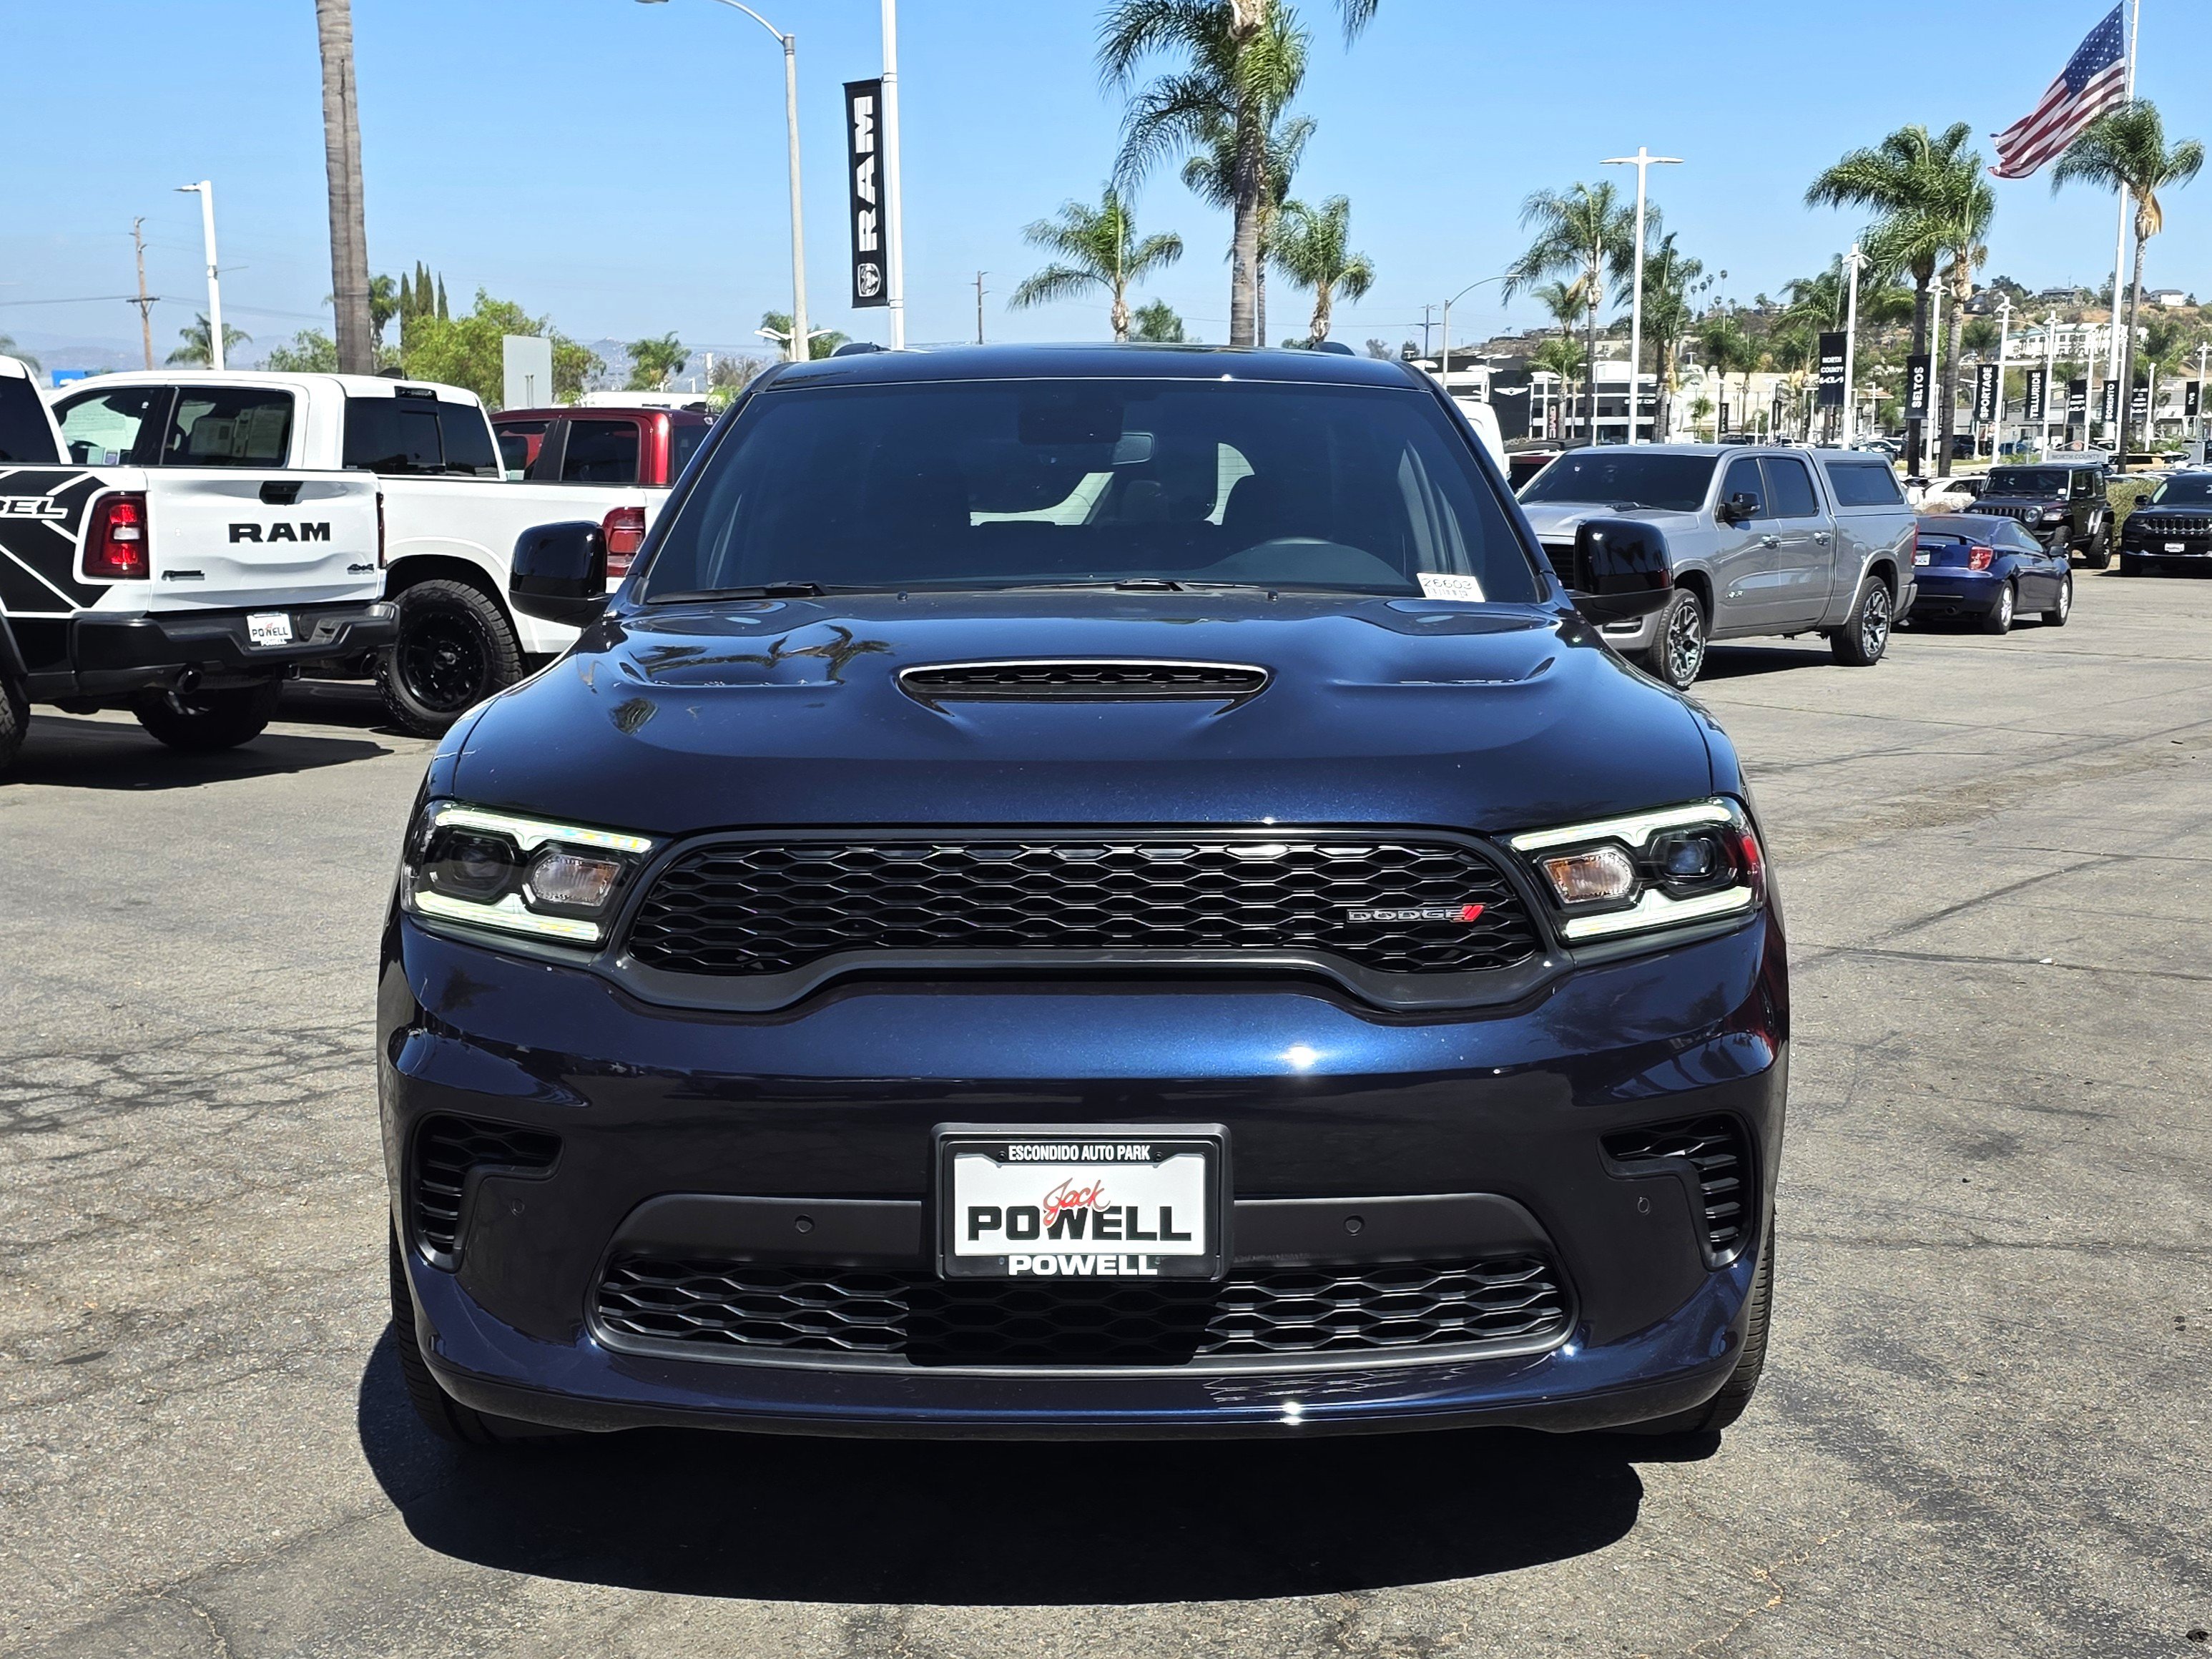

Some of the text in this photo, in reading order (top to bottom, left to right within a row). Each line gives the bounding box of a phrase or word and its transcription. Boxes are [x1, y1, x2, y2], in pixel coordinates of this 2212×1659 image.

[854, 96, 878, 252] RAM
[1912, 366, 1924, 408] SELTOS
[1980, 367, 1992, 419] SPORTAGE
[2030, 373, 2040, 419] TELLURIDE
[2105, 383, 2115, 420] SORENTO
[229, 522, 330, 543] RAM
[1348, 909, 1465, 921] DODGE
[1008, 1146, 1151, 1161] ESCONDIDO AUTO PARK
[1043, 1177, 1111, 1227] Jack
[968, 1206, 1192, 1241] POWELL
[1008, 1254, 1158, 1276] POWELL
